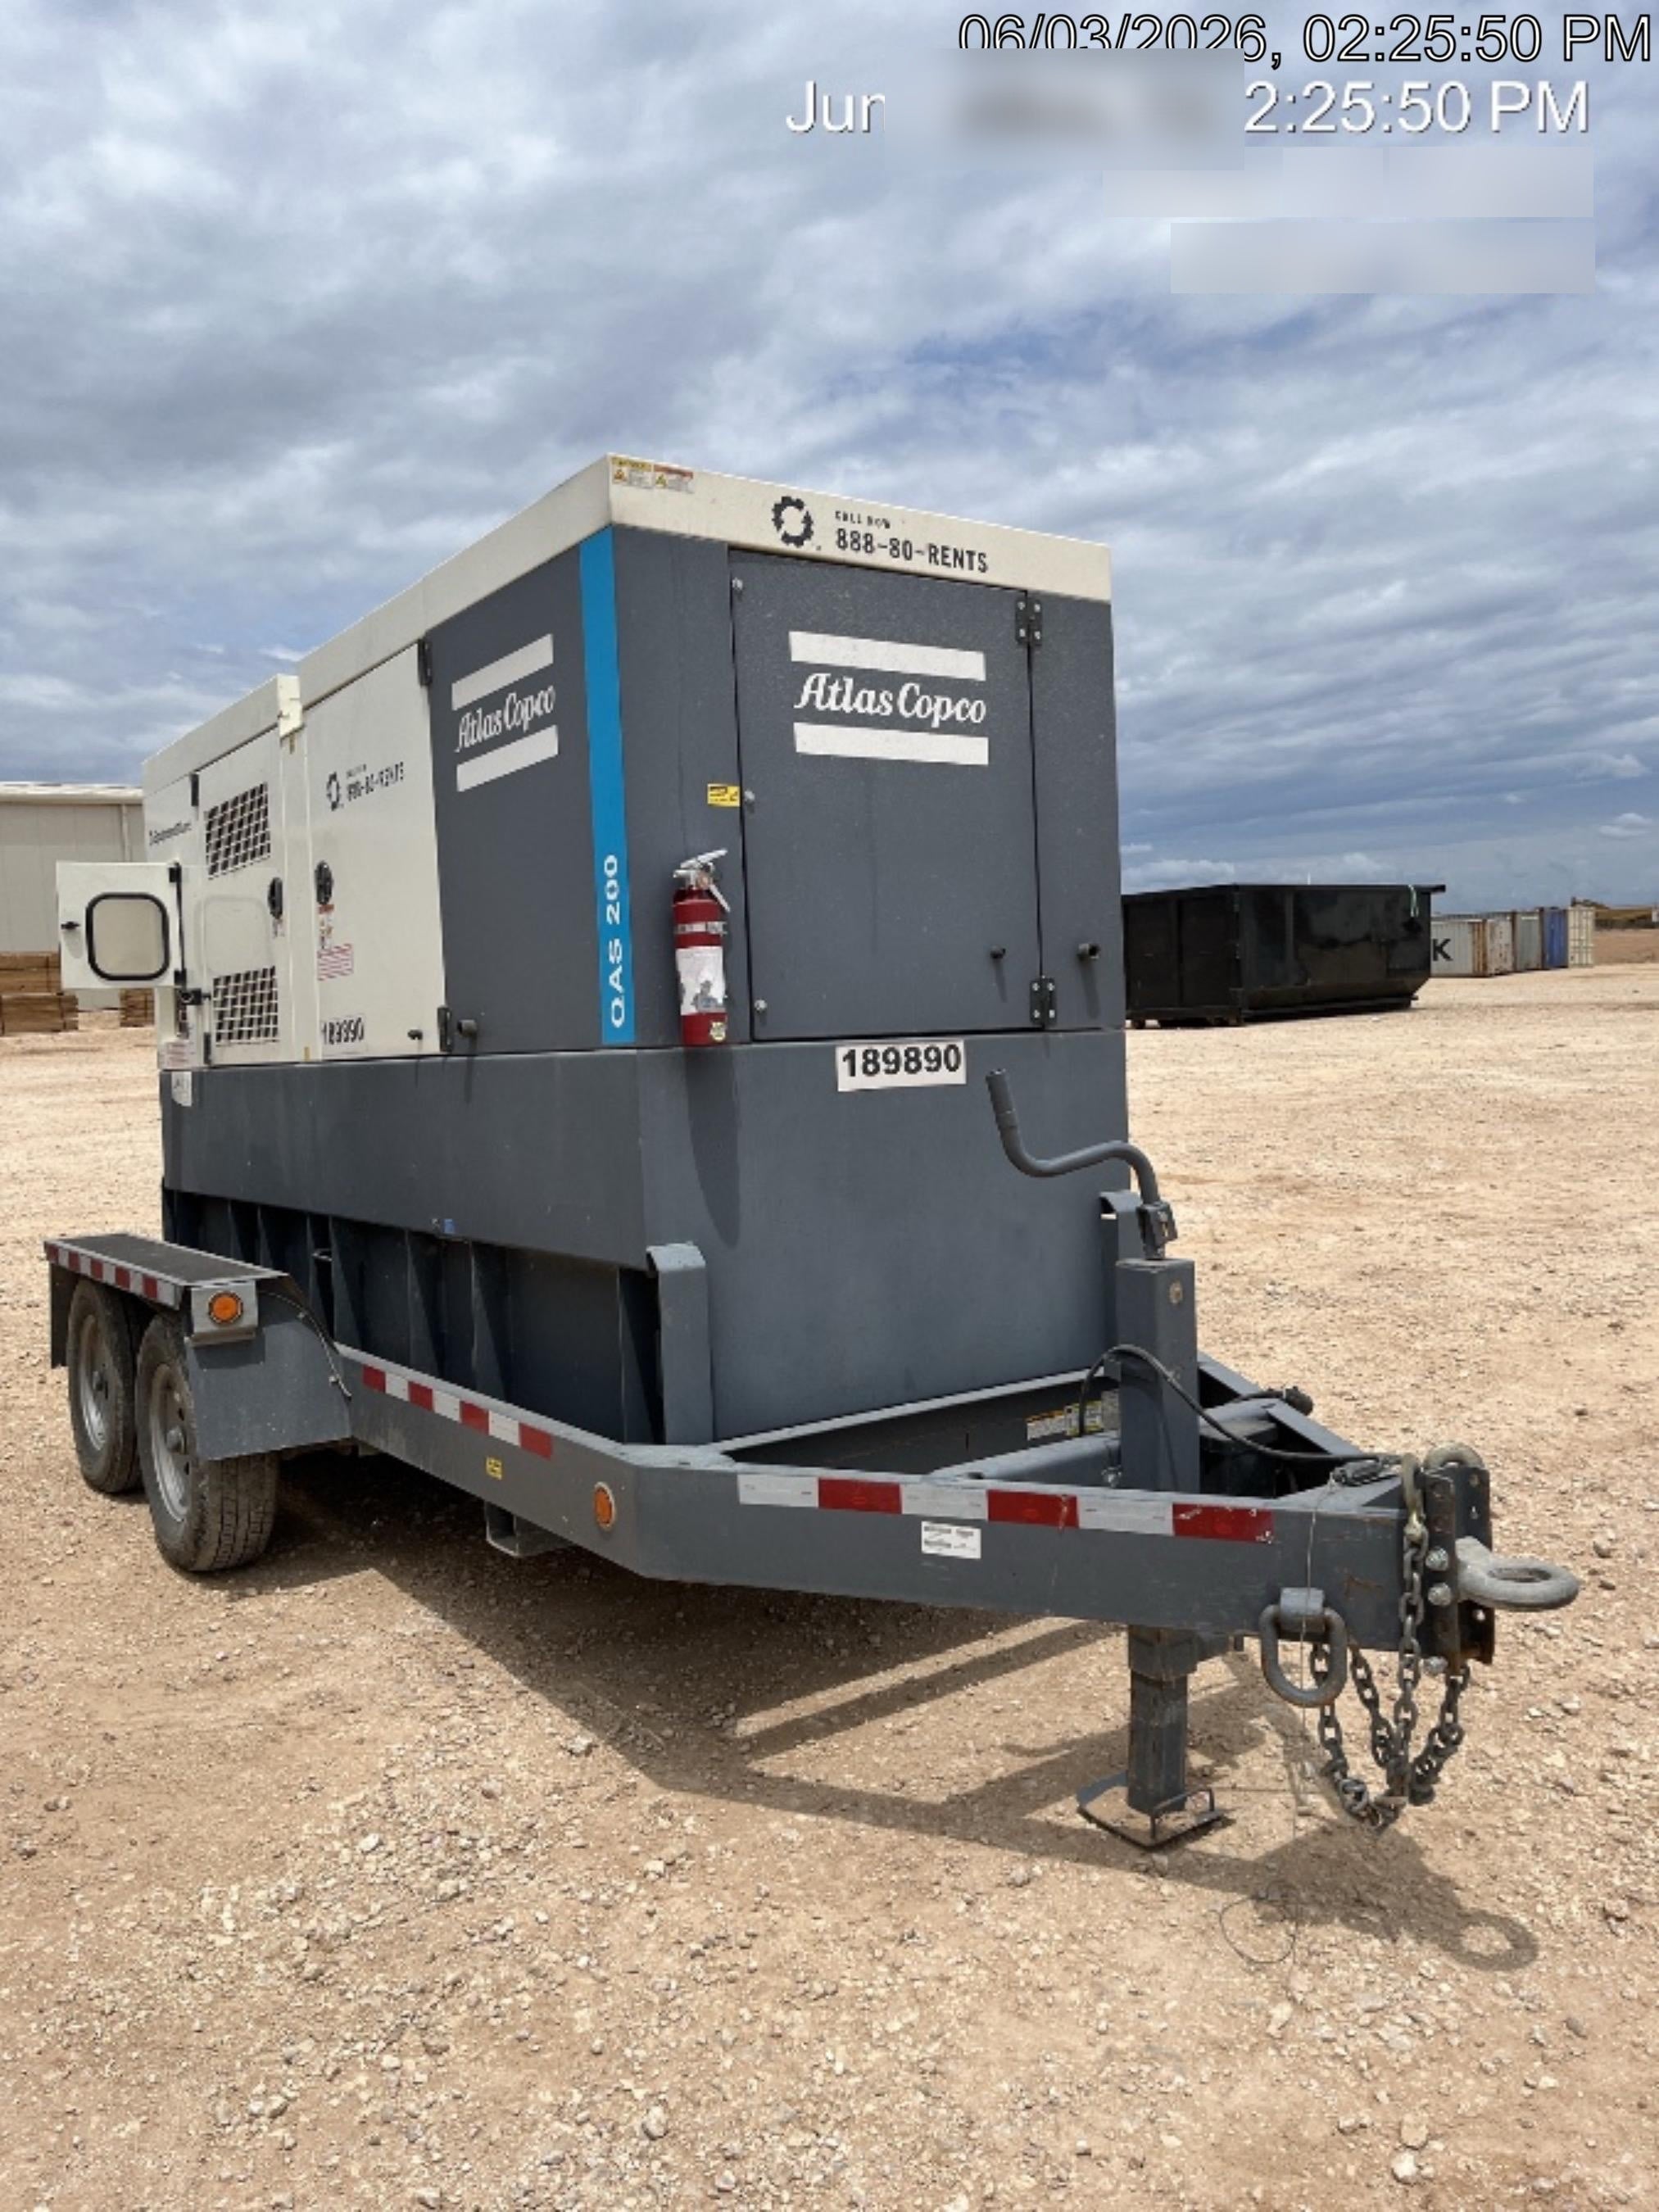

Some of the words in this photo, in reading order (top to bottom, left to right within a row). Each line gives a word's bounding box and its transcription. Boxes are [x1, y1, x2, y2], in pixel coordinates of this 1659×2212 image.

[836, 528, 988, 573] 888-80-RENTS
[454, 707, 502, 753] Atlas
[503, 685, 556, 732] Copco
[794, 673, 893, 716] Atlas
[897, 682, 986, 728] Copco
[604, 854, 620, 925] 200
[1433, 938, 1453, 962] K
[609, 938, 625, 1028] QAS
[842, 1044, 961, 1077] 189890
